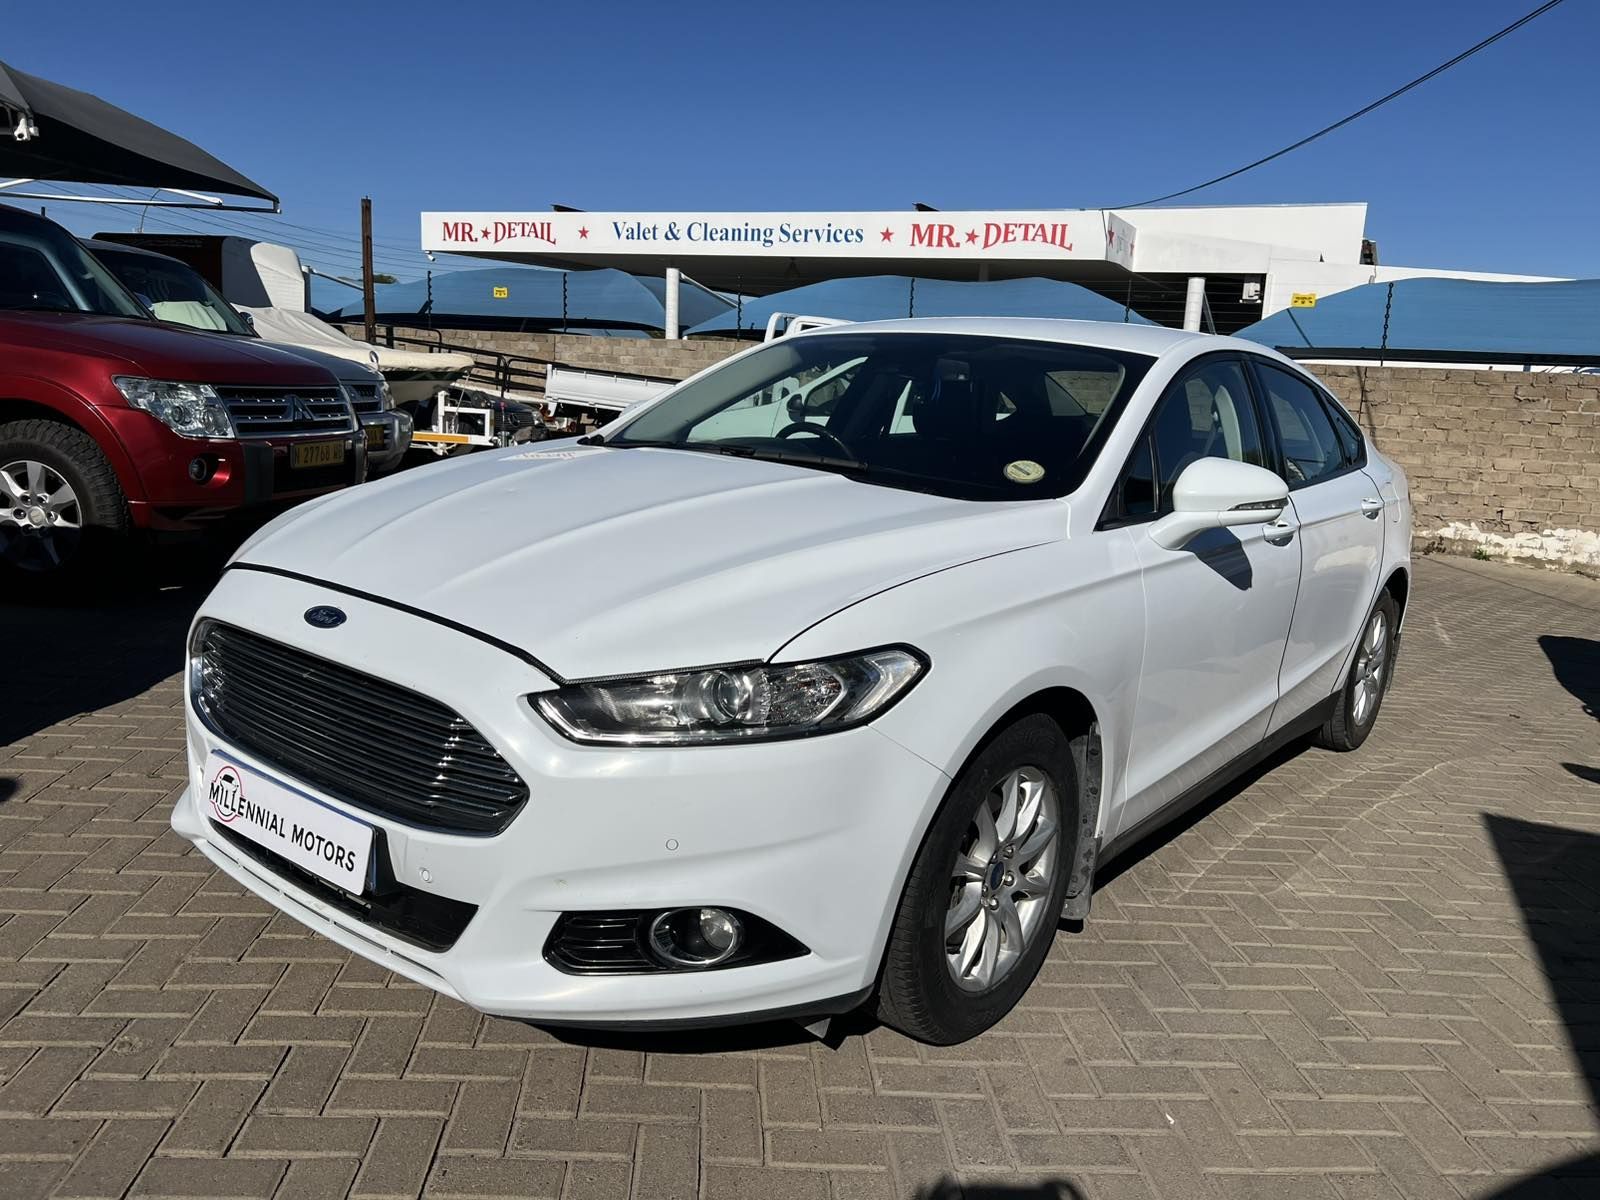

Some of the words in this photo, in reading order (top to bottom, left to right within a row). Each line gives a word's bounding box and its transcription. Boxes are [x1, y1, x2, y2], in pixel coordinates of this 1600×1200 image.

[442, 221, 478, 243] MR.
[493, 222, 556, 245] DETAIL
[613, 221, 659, 241] Valet
[664, 222, 681, 240] &
[687, 222, 774, 247] Cleaning
[779, 223, 865, 243] Services
[910, 224, 960, 248] MR.
[982, 223, 1074, 251] DETAIL
[209, 782, 285, 838] MILLENNIAL
[291, 824, 356, 872] MOTORS
